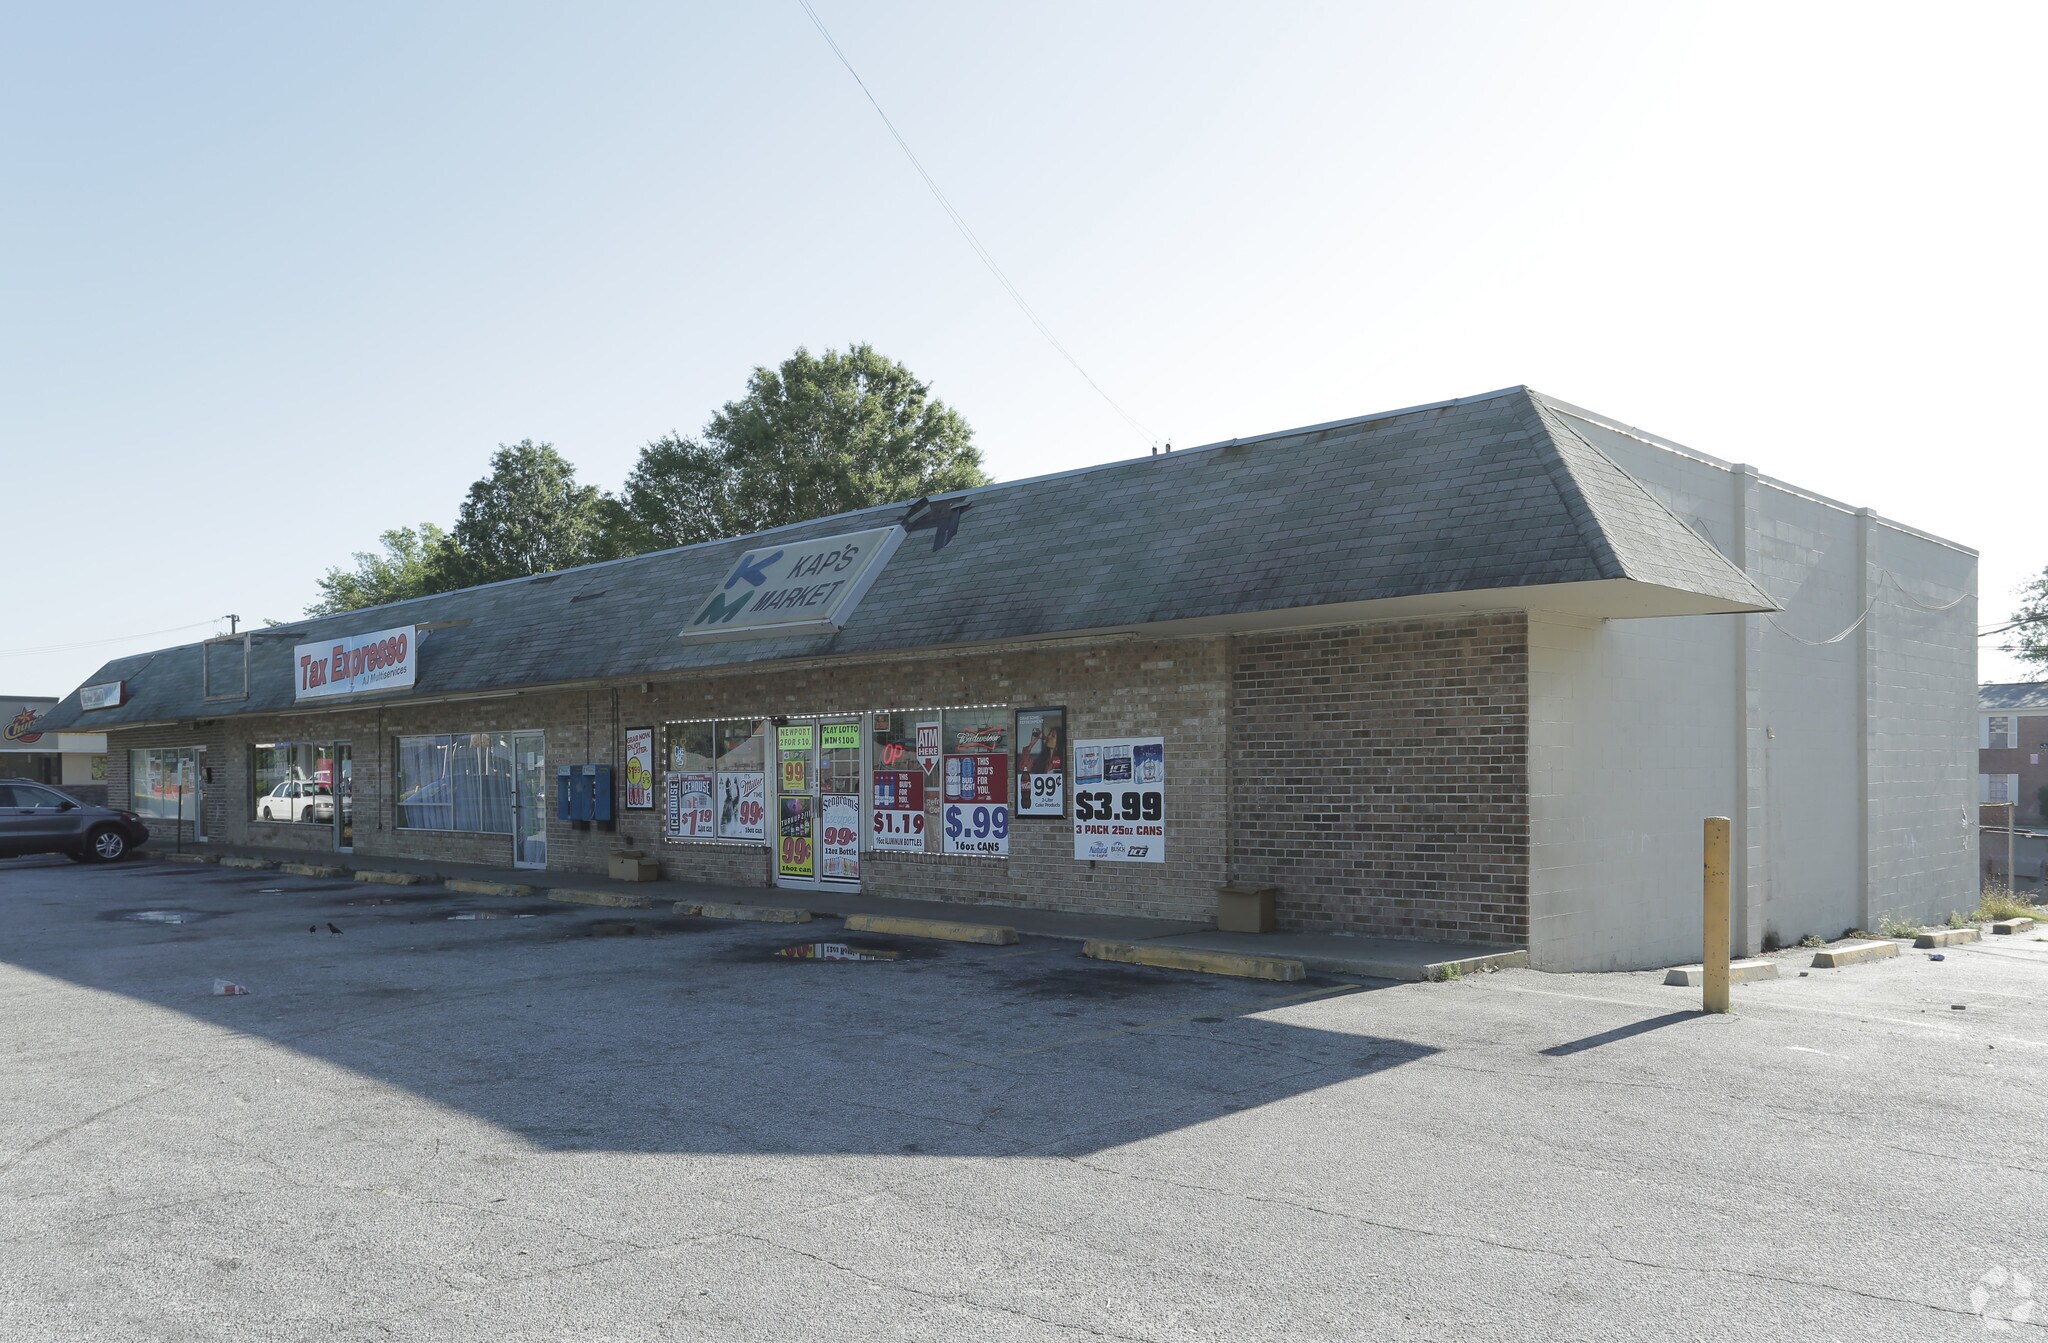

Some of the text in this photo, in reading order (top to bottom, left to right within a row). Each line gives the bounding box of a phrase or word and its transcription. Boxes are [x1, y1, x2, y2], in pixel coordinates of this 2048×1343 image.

[786, 543, 859, 580] KAP'S
[749, 580, 846, 612] MARKET
[300, 633, 407, 690] Tax Expresso
[370, 665, 407, 684] Multiservices
[780, 728, 811, 736] NEWPORT
[823, 725, 859, 734] PLAY LOTTO
[627, 735, 639, 744] GRAB
[918, 729, 938, 747] ATM
[957, 732, 1000, 744] Budweiser
[627, 742, 641, 751] ENJOY
[918, 747, 938, 756] HERE
[977, 757, 989, 765] THIS
[977, 767, 993, 775] BUD'S
[1108, 764, 1129, 774] ICE
[682, 781, 710, 795] ICEHOUSE
[740, 778, 762, 797] Miller
[1034, 775, 1061, 796] 99¢
[670, 782, 679, 829] ICEHOUSE
[823, 796, 859, 812] Seagram's
[1076, 790, 1162, 822] $3.99
[740, 801, 764, 825] 99¢
[781, 816, 794, 827] TURN
[794, 814, 801, 822] UP
[873, 811, 924, 834] $1.19
[945, 805, 1008, 841] $.99
[824, 827, 857, 845] 99¢
[1076, 825, 1163, 835] 3 PACK 25oz CANS
[782, 837, 811, 864] 99¢
[839, 848, 857, 856] Bottle
[955, 841, 999, 851] 16oz CANS
[1089, 846, 1108, 854] Natural
[1129, 847, 1146, 856] ICE
